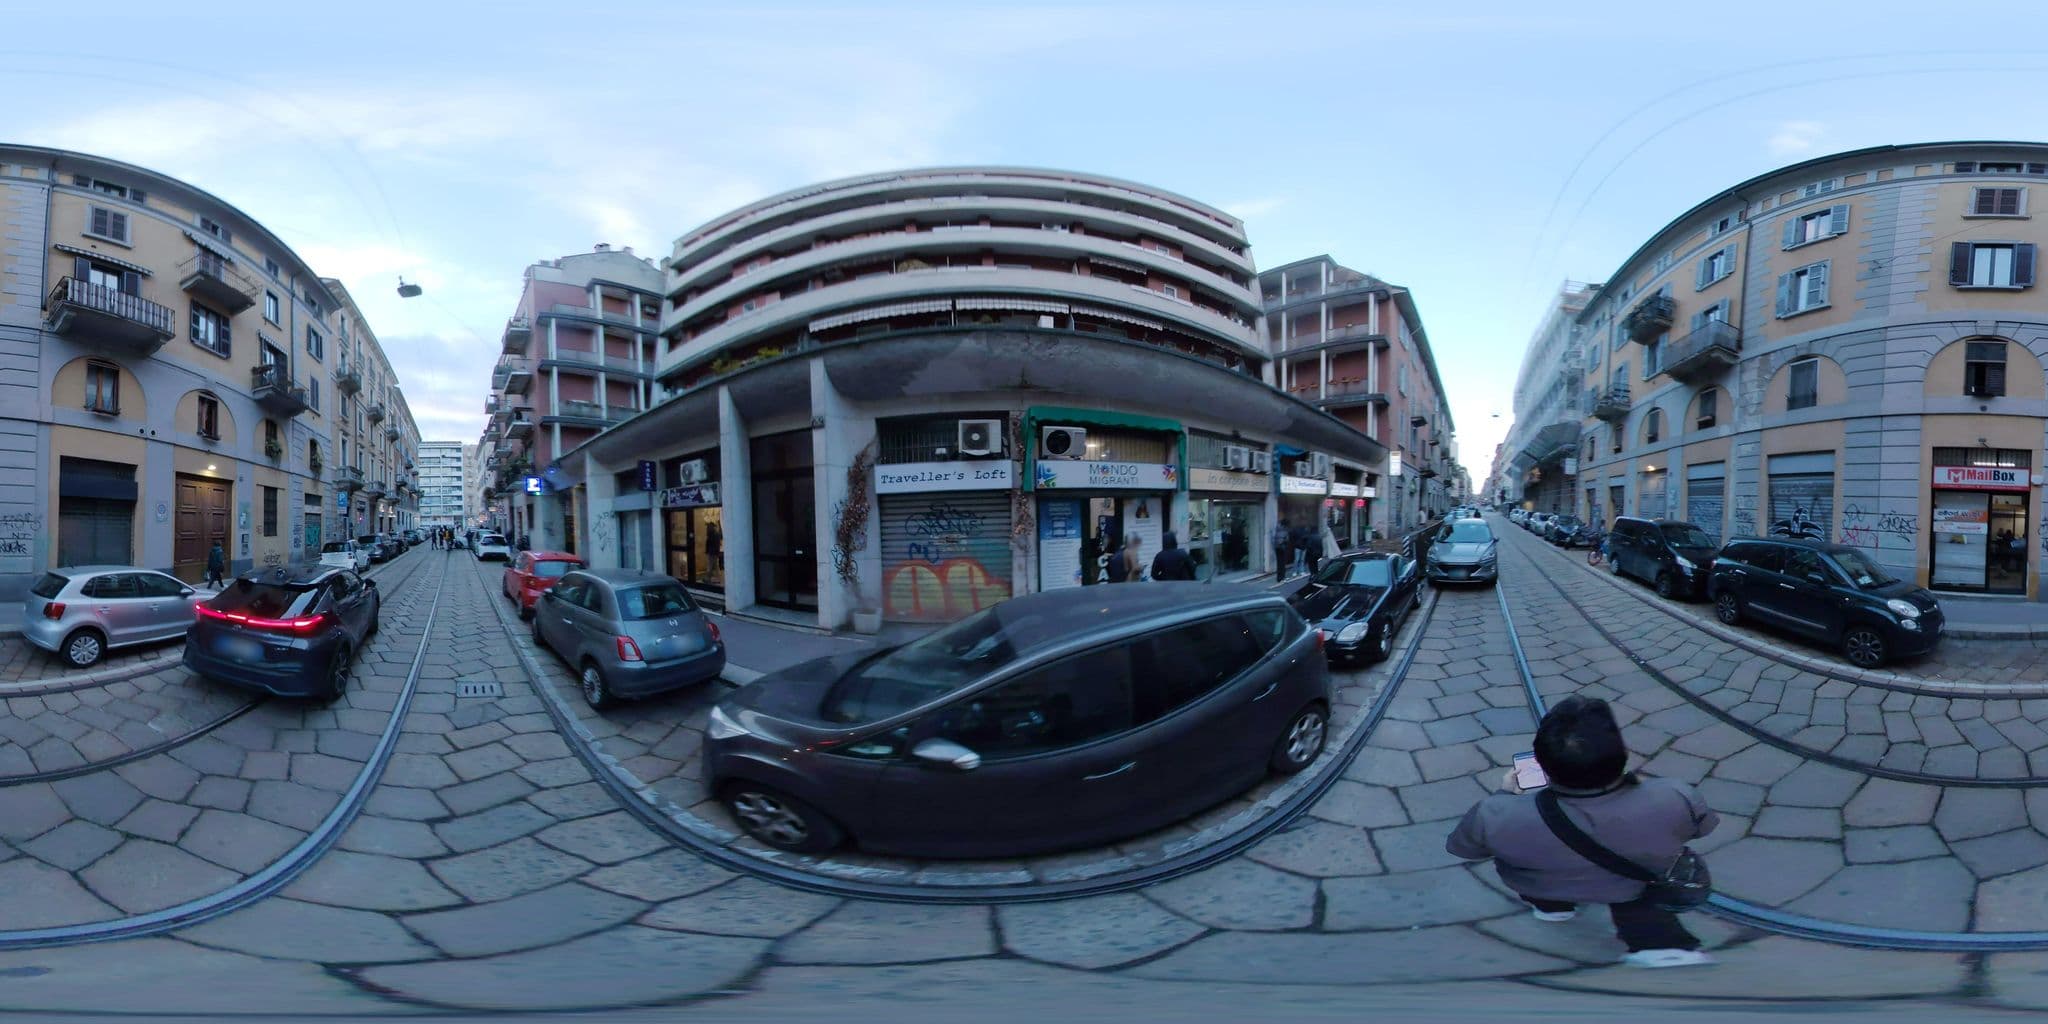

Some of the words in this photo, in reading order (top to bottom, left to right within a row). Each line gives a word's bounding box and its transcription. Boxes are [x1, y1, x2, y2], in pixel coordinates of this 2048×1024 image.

[1089, 464, 1138, 476] MONDO
[1967, 469, 2015, 481] MailBox
[881, 471, 964, 484] Traveller's
[974, 470, 1007, 480] Loft
[1089, 477, 1138, 485] MIGRANTI
